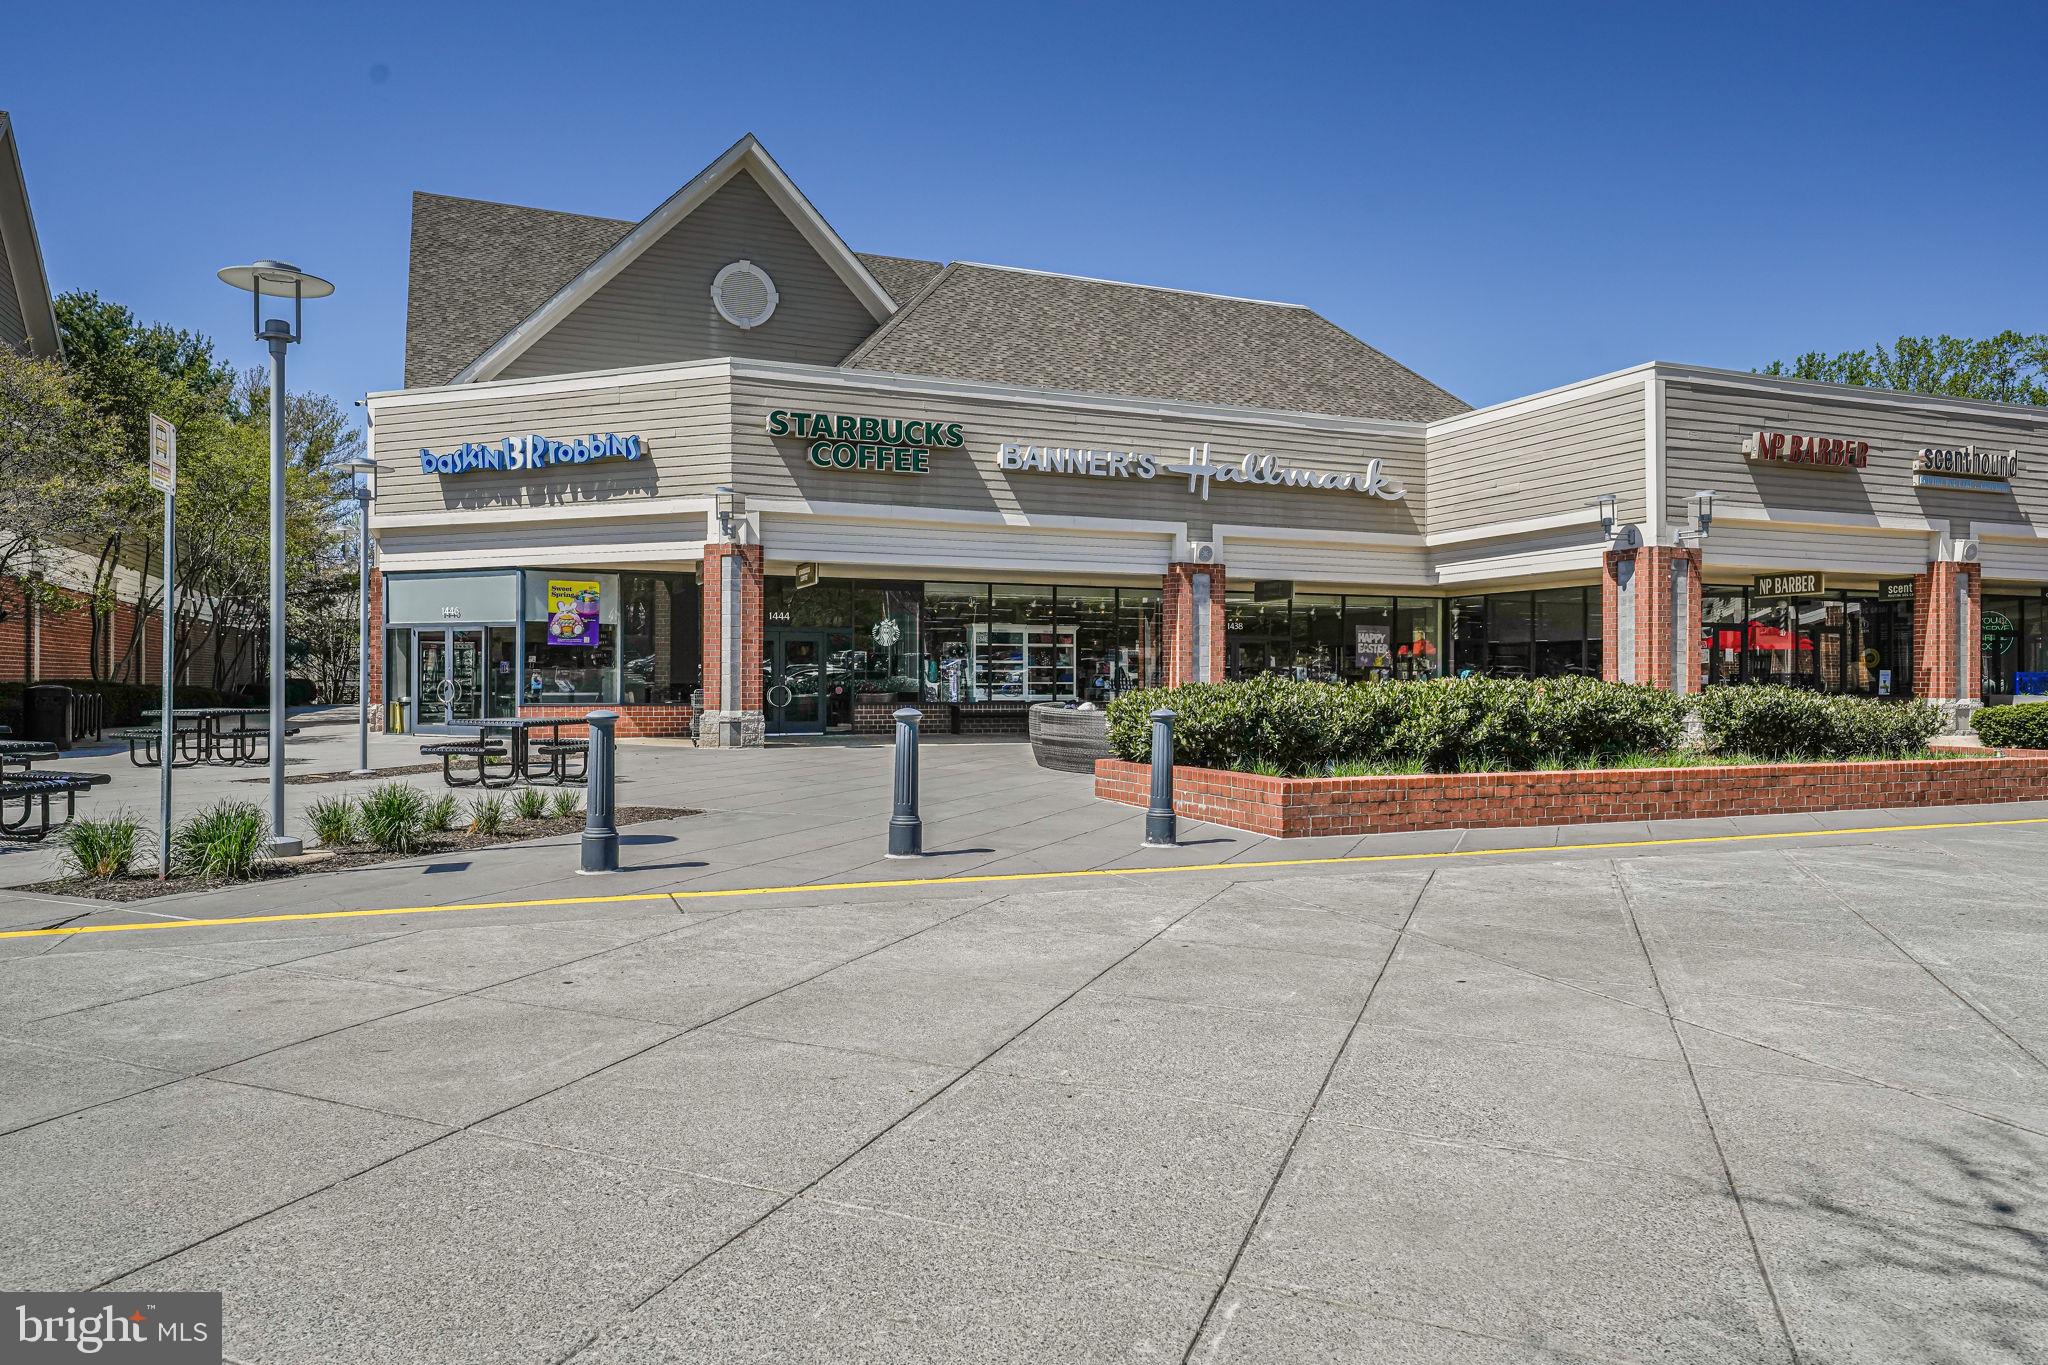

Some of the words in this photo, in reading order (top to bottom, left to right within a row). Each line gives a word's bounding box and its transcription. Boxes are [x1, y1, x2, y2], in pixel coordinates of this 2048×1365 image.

[768, 409, 965, 448] STARBUCKS
[419, 443, 501, 474] baskin
[548, 432, 640, 463] robbins
[810, 440, 930, 473] COFFEE
[1758, 431, 1786, 460] NP
[1788, 434, 1869, 468] BARBER
[1923, 445, 2018, 478] scenthound
[1000, 443, 1156, 480] BANNER'S
[1165, 442, 1407, 501] Hallmark
[551, 591, 575, 599] Spring
[1759, 578, 1772, 595] NP
[1774, 574, 1815, 594] BARBER
[769, 611, 790, 621] 1444
[1227, 622, 1244, 630] 1438
[1357, 632, 1386, 643] HAPPY
[1357, 643, 1389, 654] EASTER
